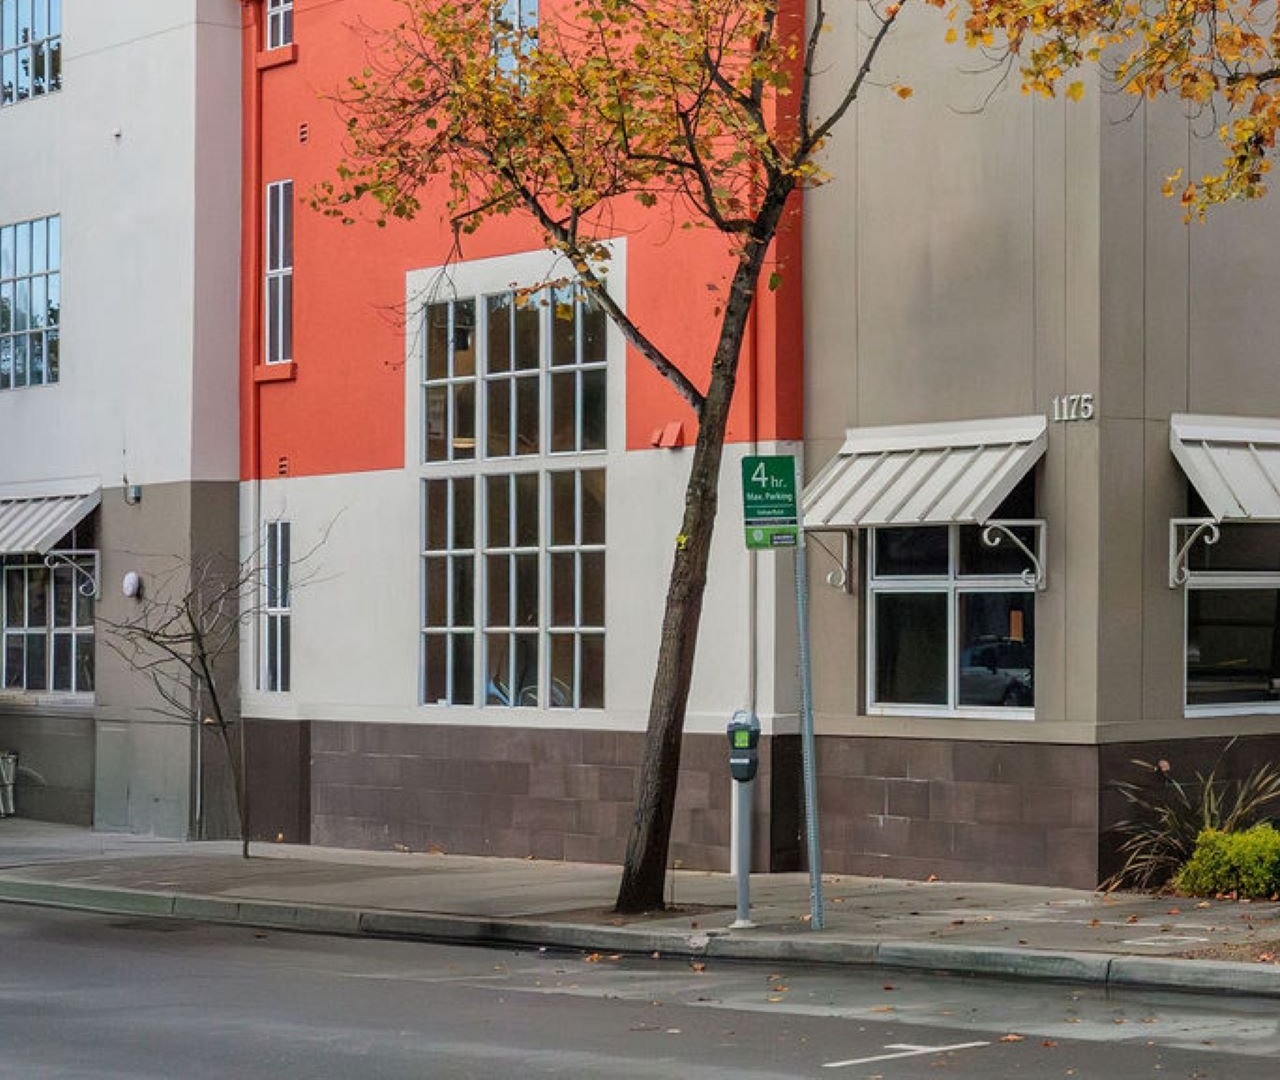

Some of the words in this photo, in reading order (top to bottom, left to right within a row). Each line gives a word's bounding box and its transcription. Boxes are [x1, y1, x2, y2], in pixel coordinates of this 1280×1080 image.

[1053, 393, 1093, 421] 1175
[751, 461, 769, 488] 4
[770, 475, 787, 488] hr.
[765, 491, 793, 503] Parking
